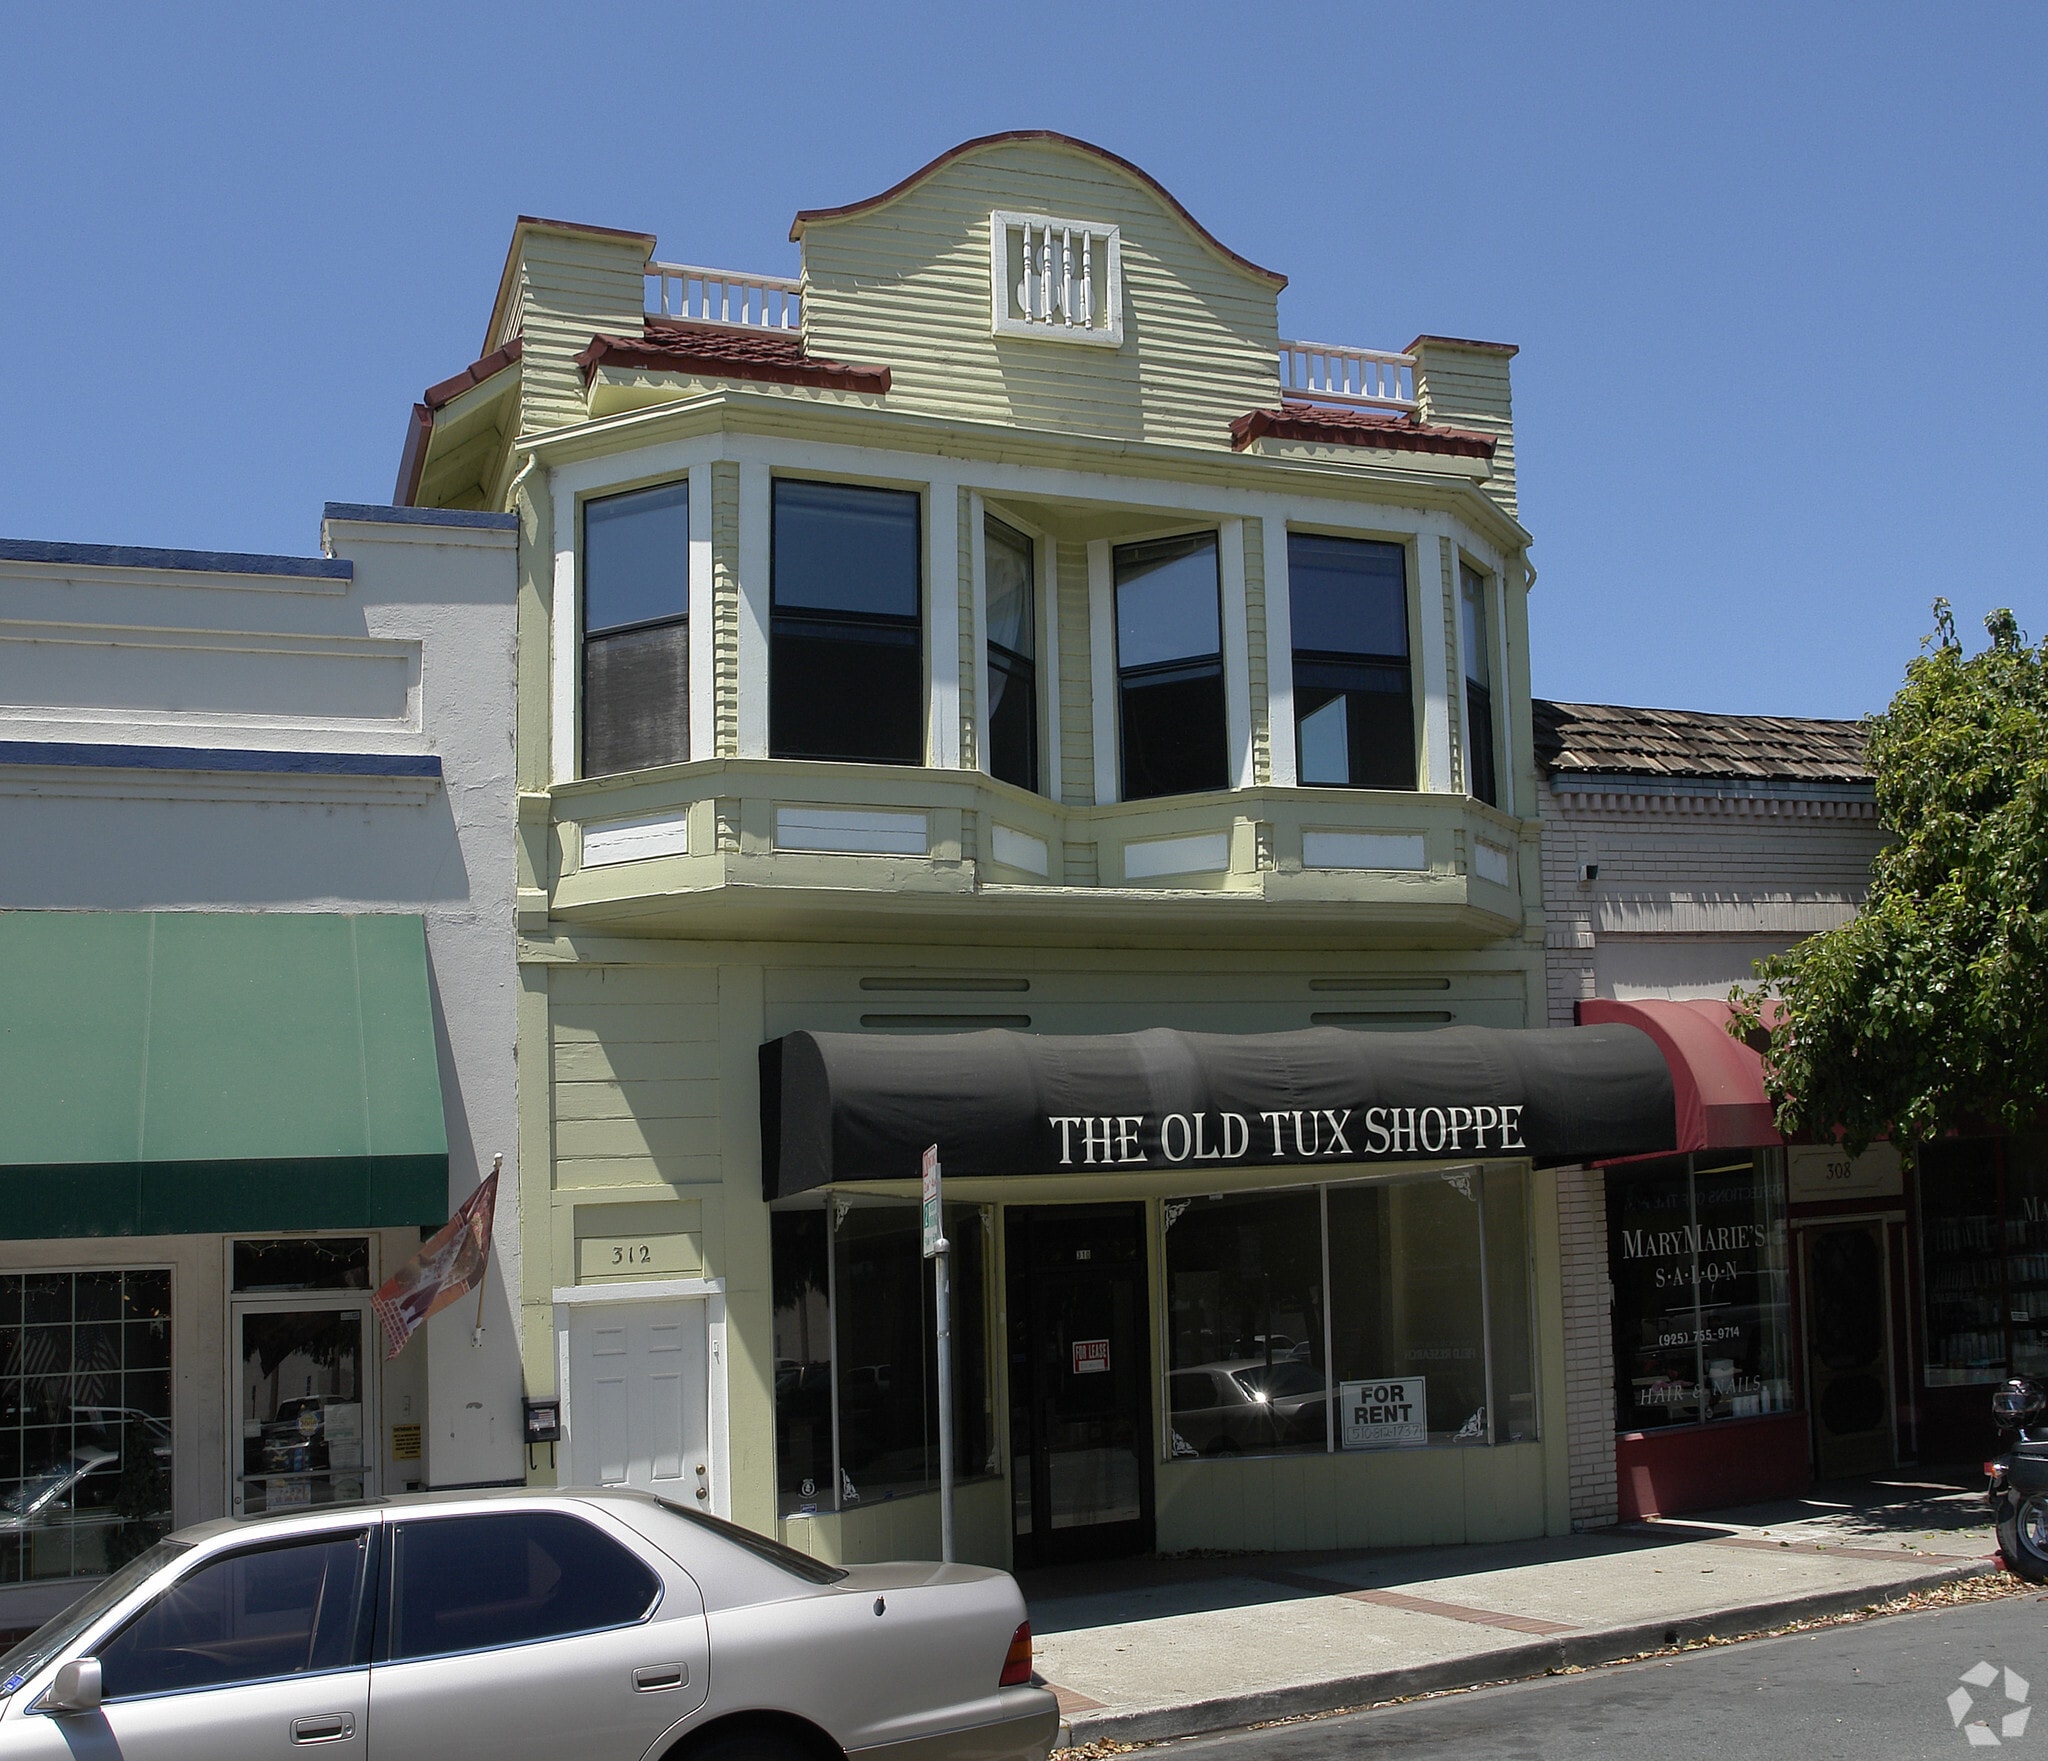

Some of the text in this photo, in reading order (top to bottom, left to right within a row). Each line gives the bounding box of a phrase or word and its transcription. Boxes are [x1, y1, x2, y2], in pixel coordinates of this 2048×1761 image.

[1049, 1104, 1526, 1164] THE OLD TUX SHOPPE
[1826, 1161, 1852, 1180] 308
[611, 1245, 652, 1265] 312
[1658, 1331, 1689, 1347] (925)
[1075, 1343, 1107, 1361] FOR LEASE
[1361, 1384, 1405, 1404] FOR
[1640, 1384, 1684, 1406] HAIR
[1713, 1375, 1762, 1396] NAILS
[1354, 1404, 1413, 1425] RENT
